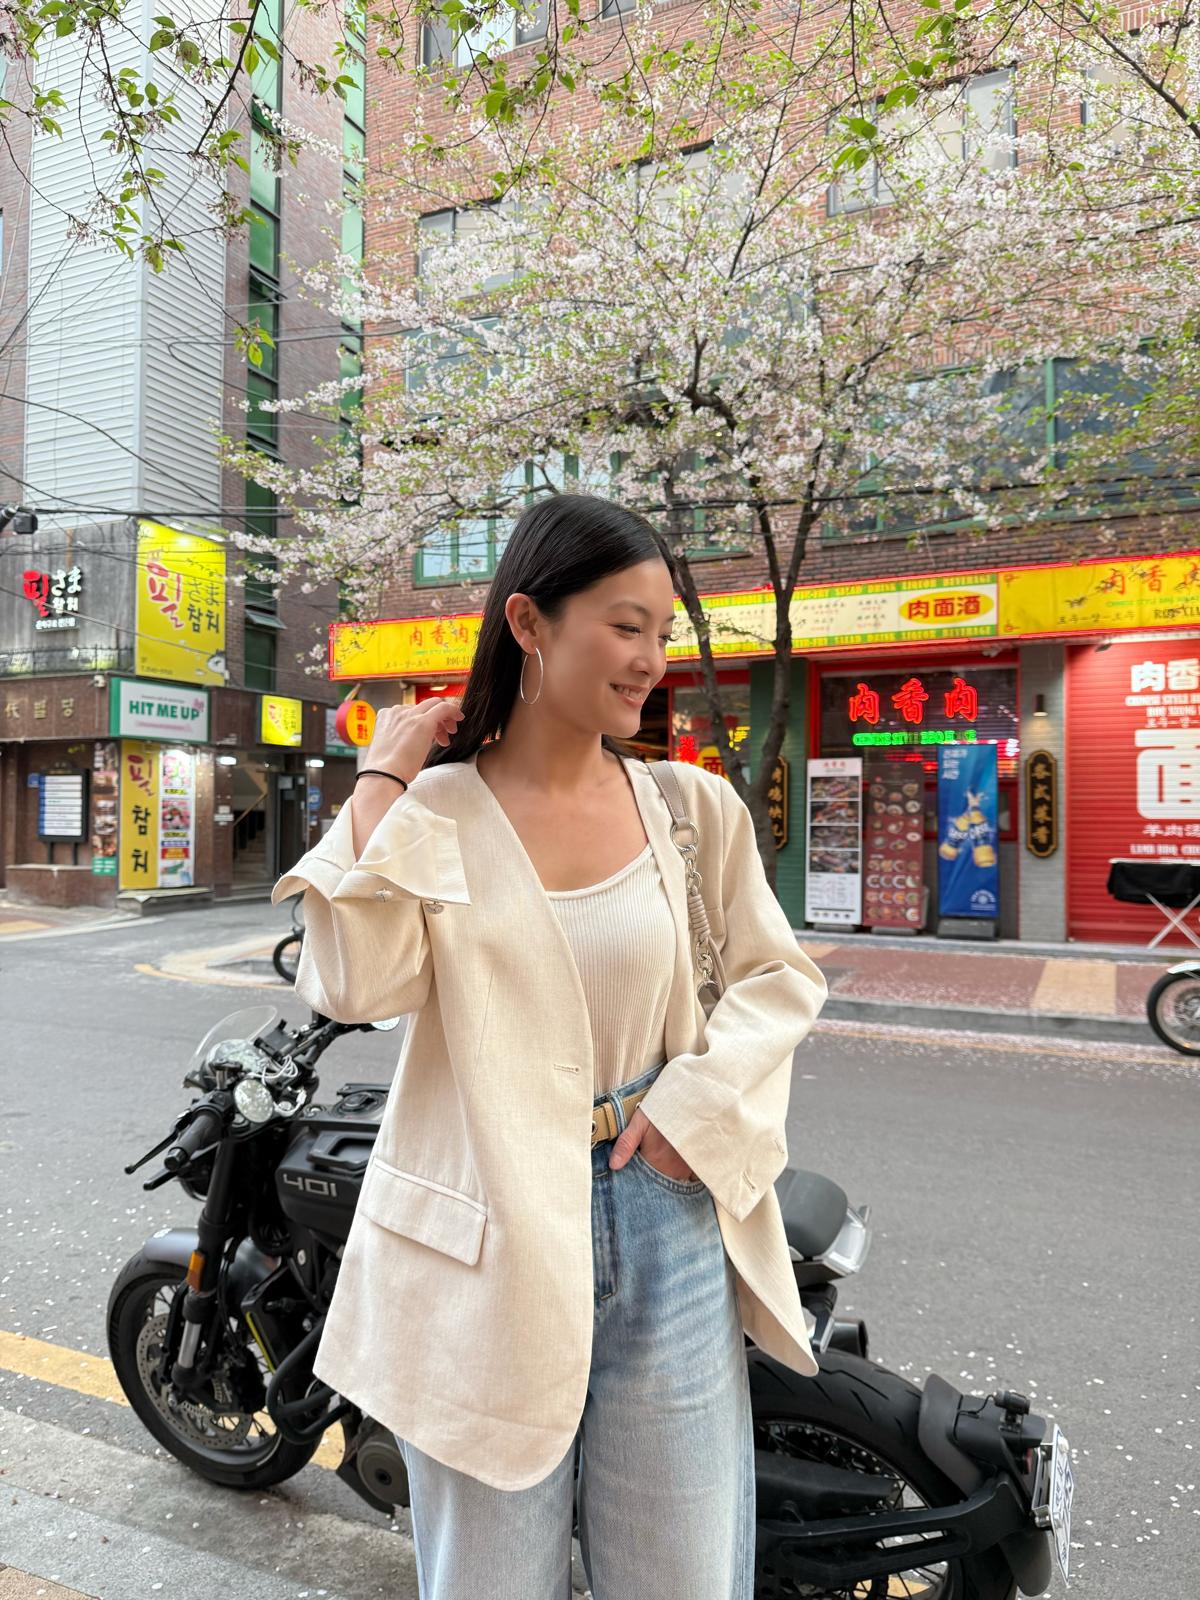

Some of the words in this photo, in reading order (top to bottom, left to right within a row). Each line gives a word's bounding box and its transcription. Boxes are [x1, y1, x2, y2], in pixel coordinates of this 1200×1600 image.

[187, 603, 220, 633] 참치
[908, 595, 980, 620] 肉面酒
[129, 700, 154, 716] HIT
[157, 703, 178, 719] ME
[181, 706, 200, 721] UP
[848, 677, 979, 726] 肉香肉
[283, 1173, 337, 1197] 401
